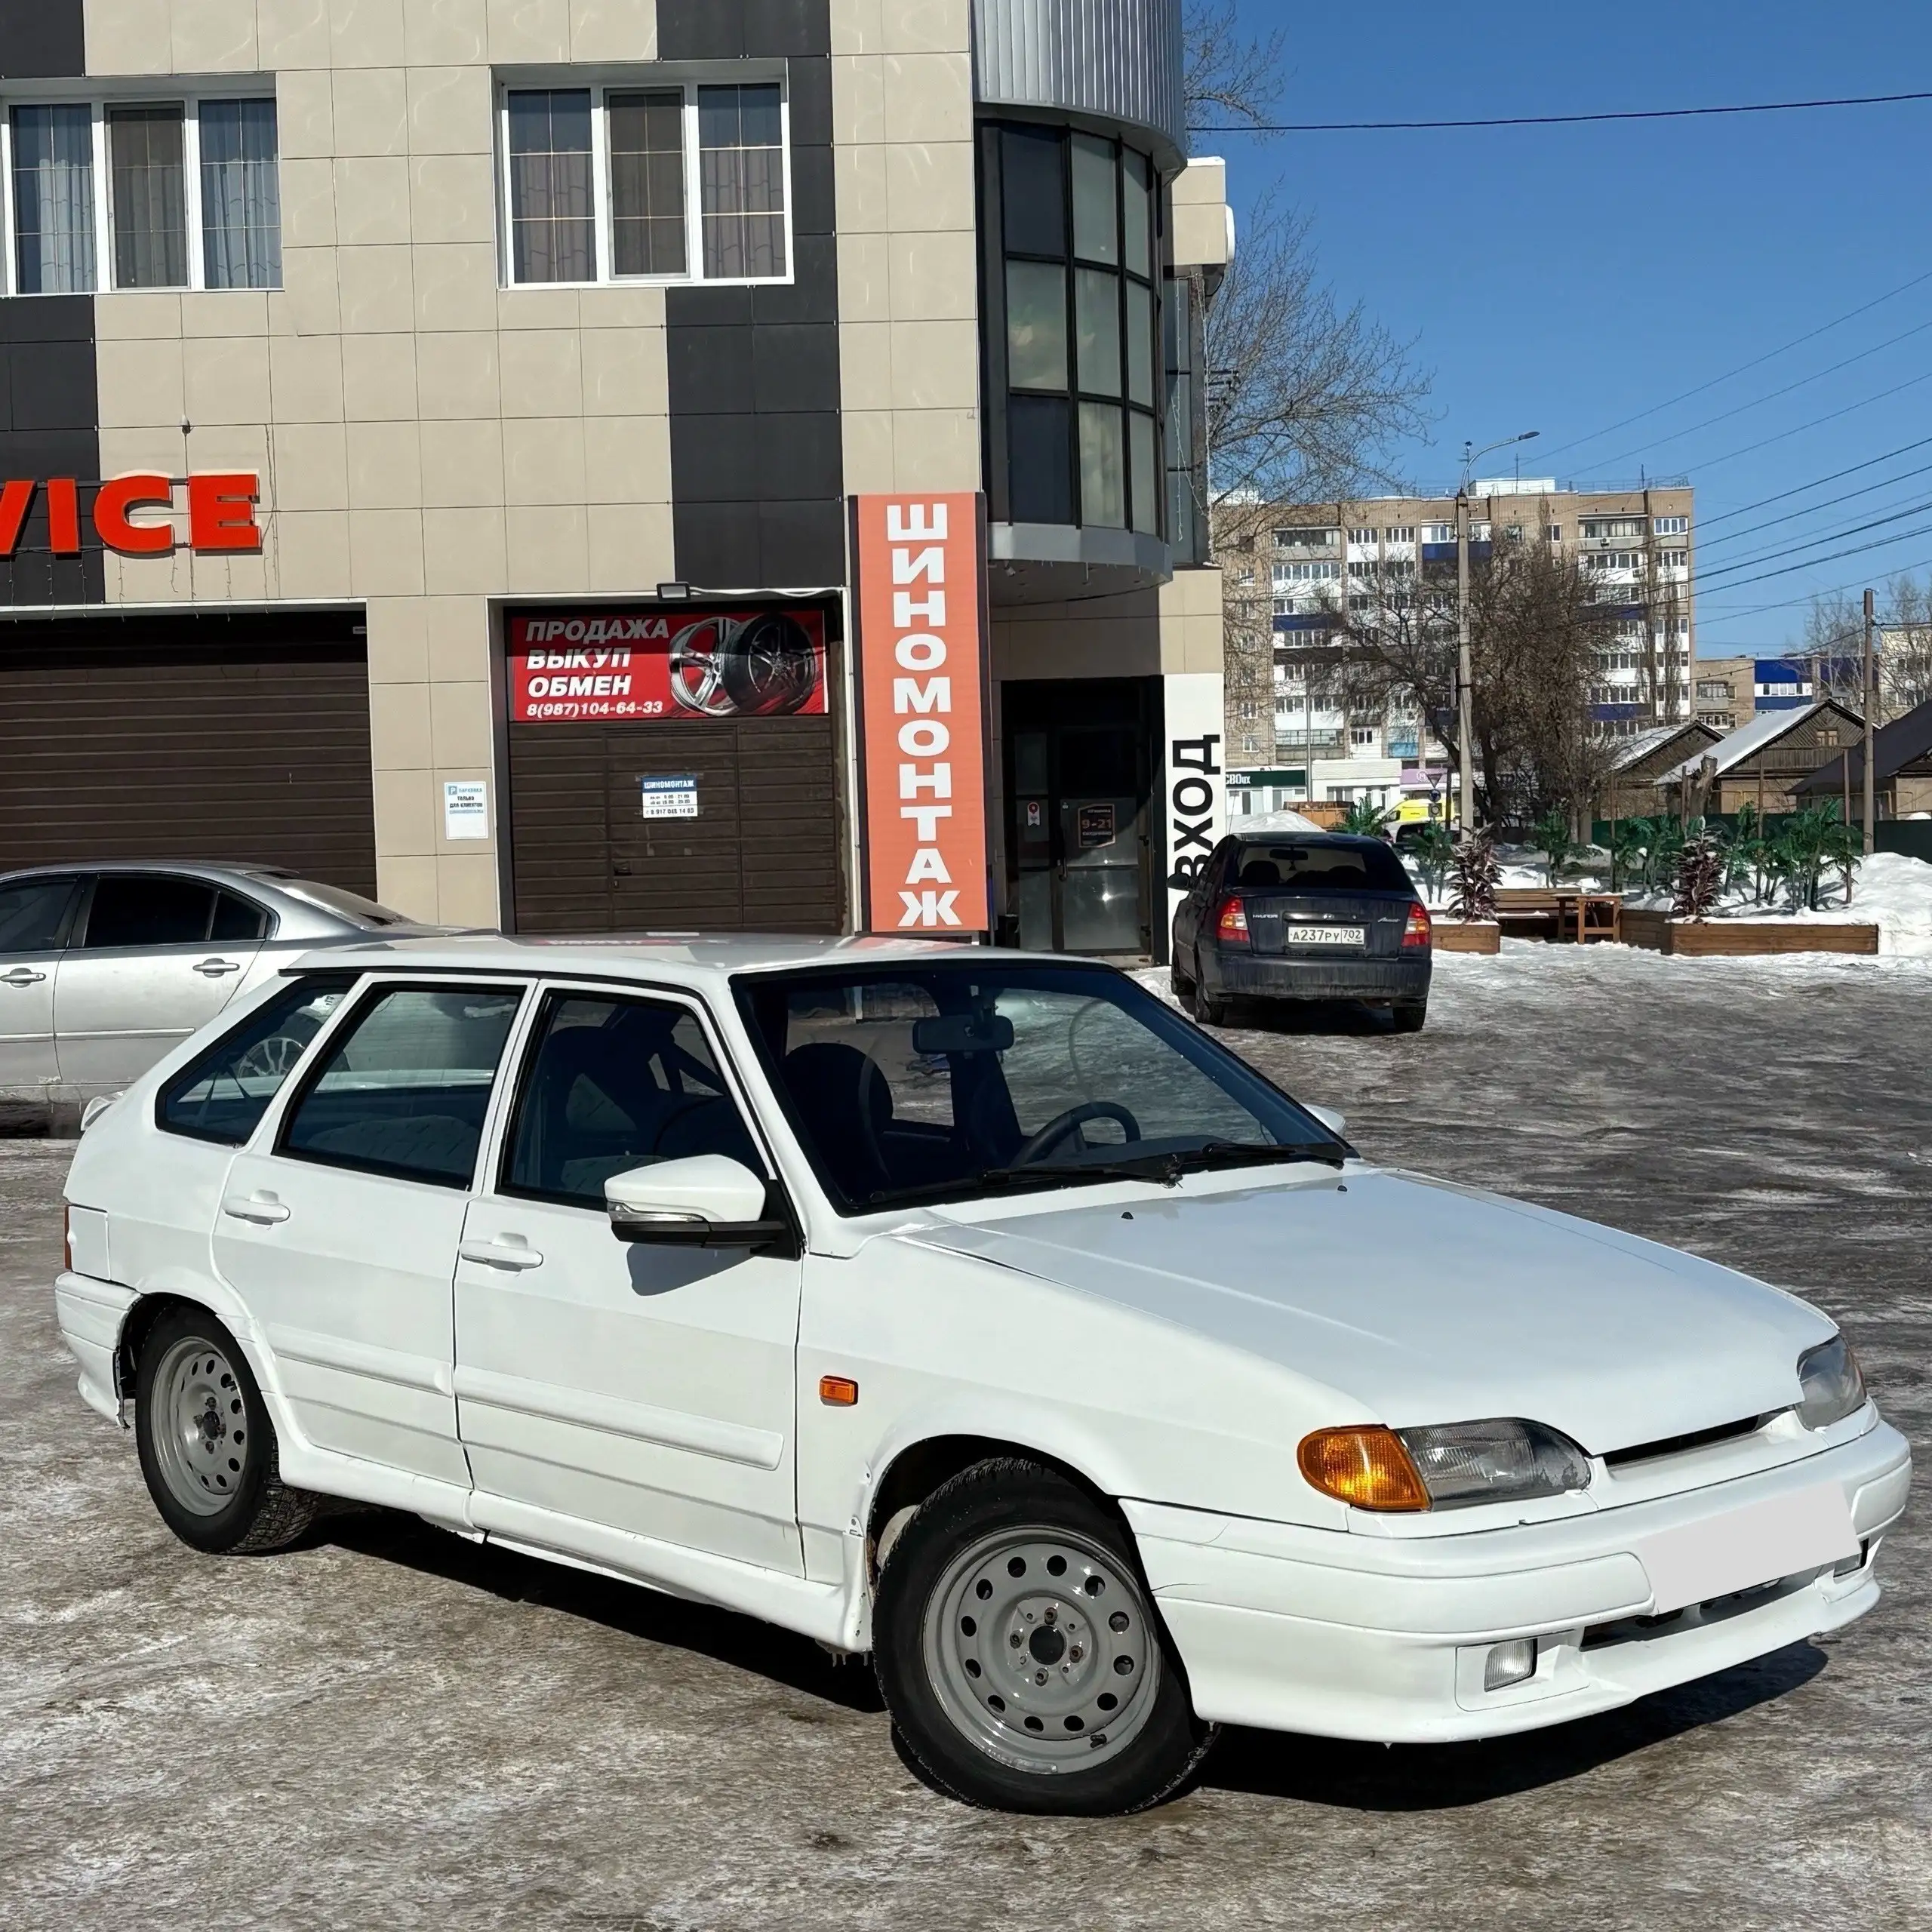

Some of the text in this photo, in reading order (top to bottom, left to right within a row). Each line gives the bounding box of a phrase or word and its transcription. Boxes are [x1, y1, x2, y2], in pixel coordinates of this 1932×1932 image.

[526, 618, 669, 644] ПРОДАЖА
[527, 647, 632, 669] ВЫКУП
[528, 675, 632, 697] ОБМЕН
[527, 701, 663, 718] 8(987)104-64-33
[886, 503, 963, 928] ШИНОМОНТАЖ
[1293, 929, 1361, 942] А237РУ 702
